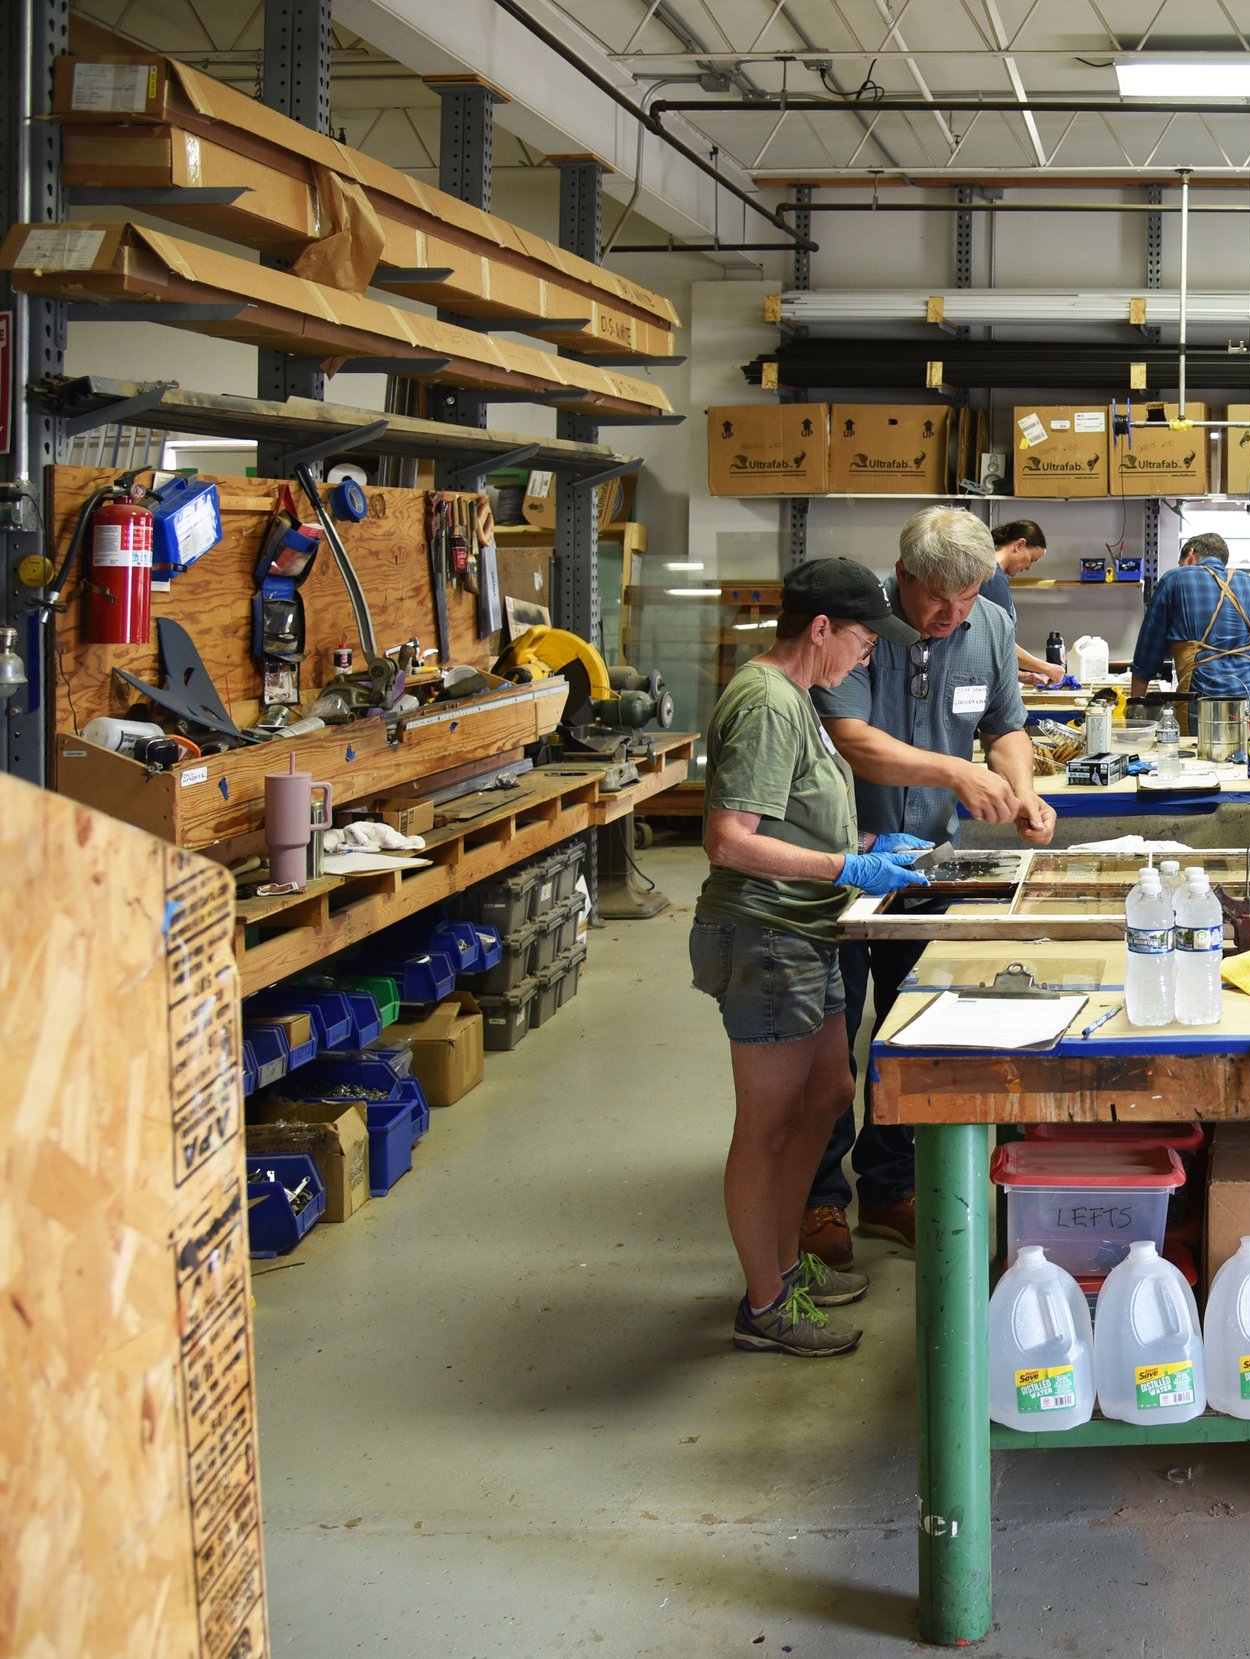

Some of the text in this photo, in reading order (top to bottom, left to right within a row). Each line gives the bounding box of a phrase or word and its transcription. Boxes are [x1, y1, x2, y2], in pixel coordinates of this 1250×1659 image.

[843, 430, 855, 438] UP
[748, 459, 789, 470] Ultrafab
[869, 458, 908, 469] Ultrafab
[1042, 461, 1082, 472] Ultrafab
[1138, 459, 1178, 470] Ultrafab
[1057, 1206, 1132, 1228] LEFTS
[1019, 1373, 1040, 1382] Save
[1138, 1370, 1158, 1380] Save
[1021, 1379, 1052, 1395] DISTILLED
[1140, 1376, 1171, 1392] DISTILLED
[1030, 1388, 1053, 1398] WATER
[1149, 1385, 1172, 1396] WATER
